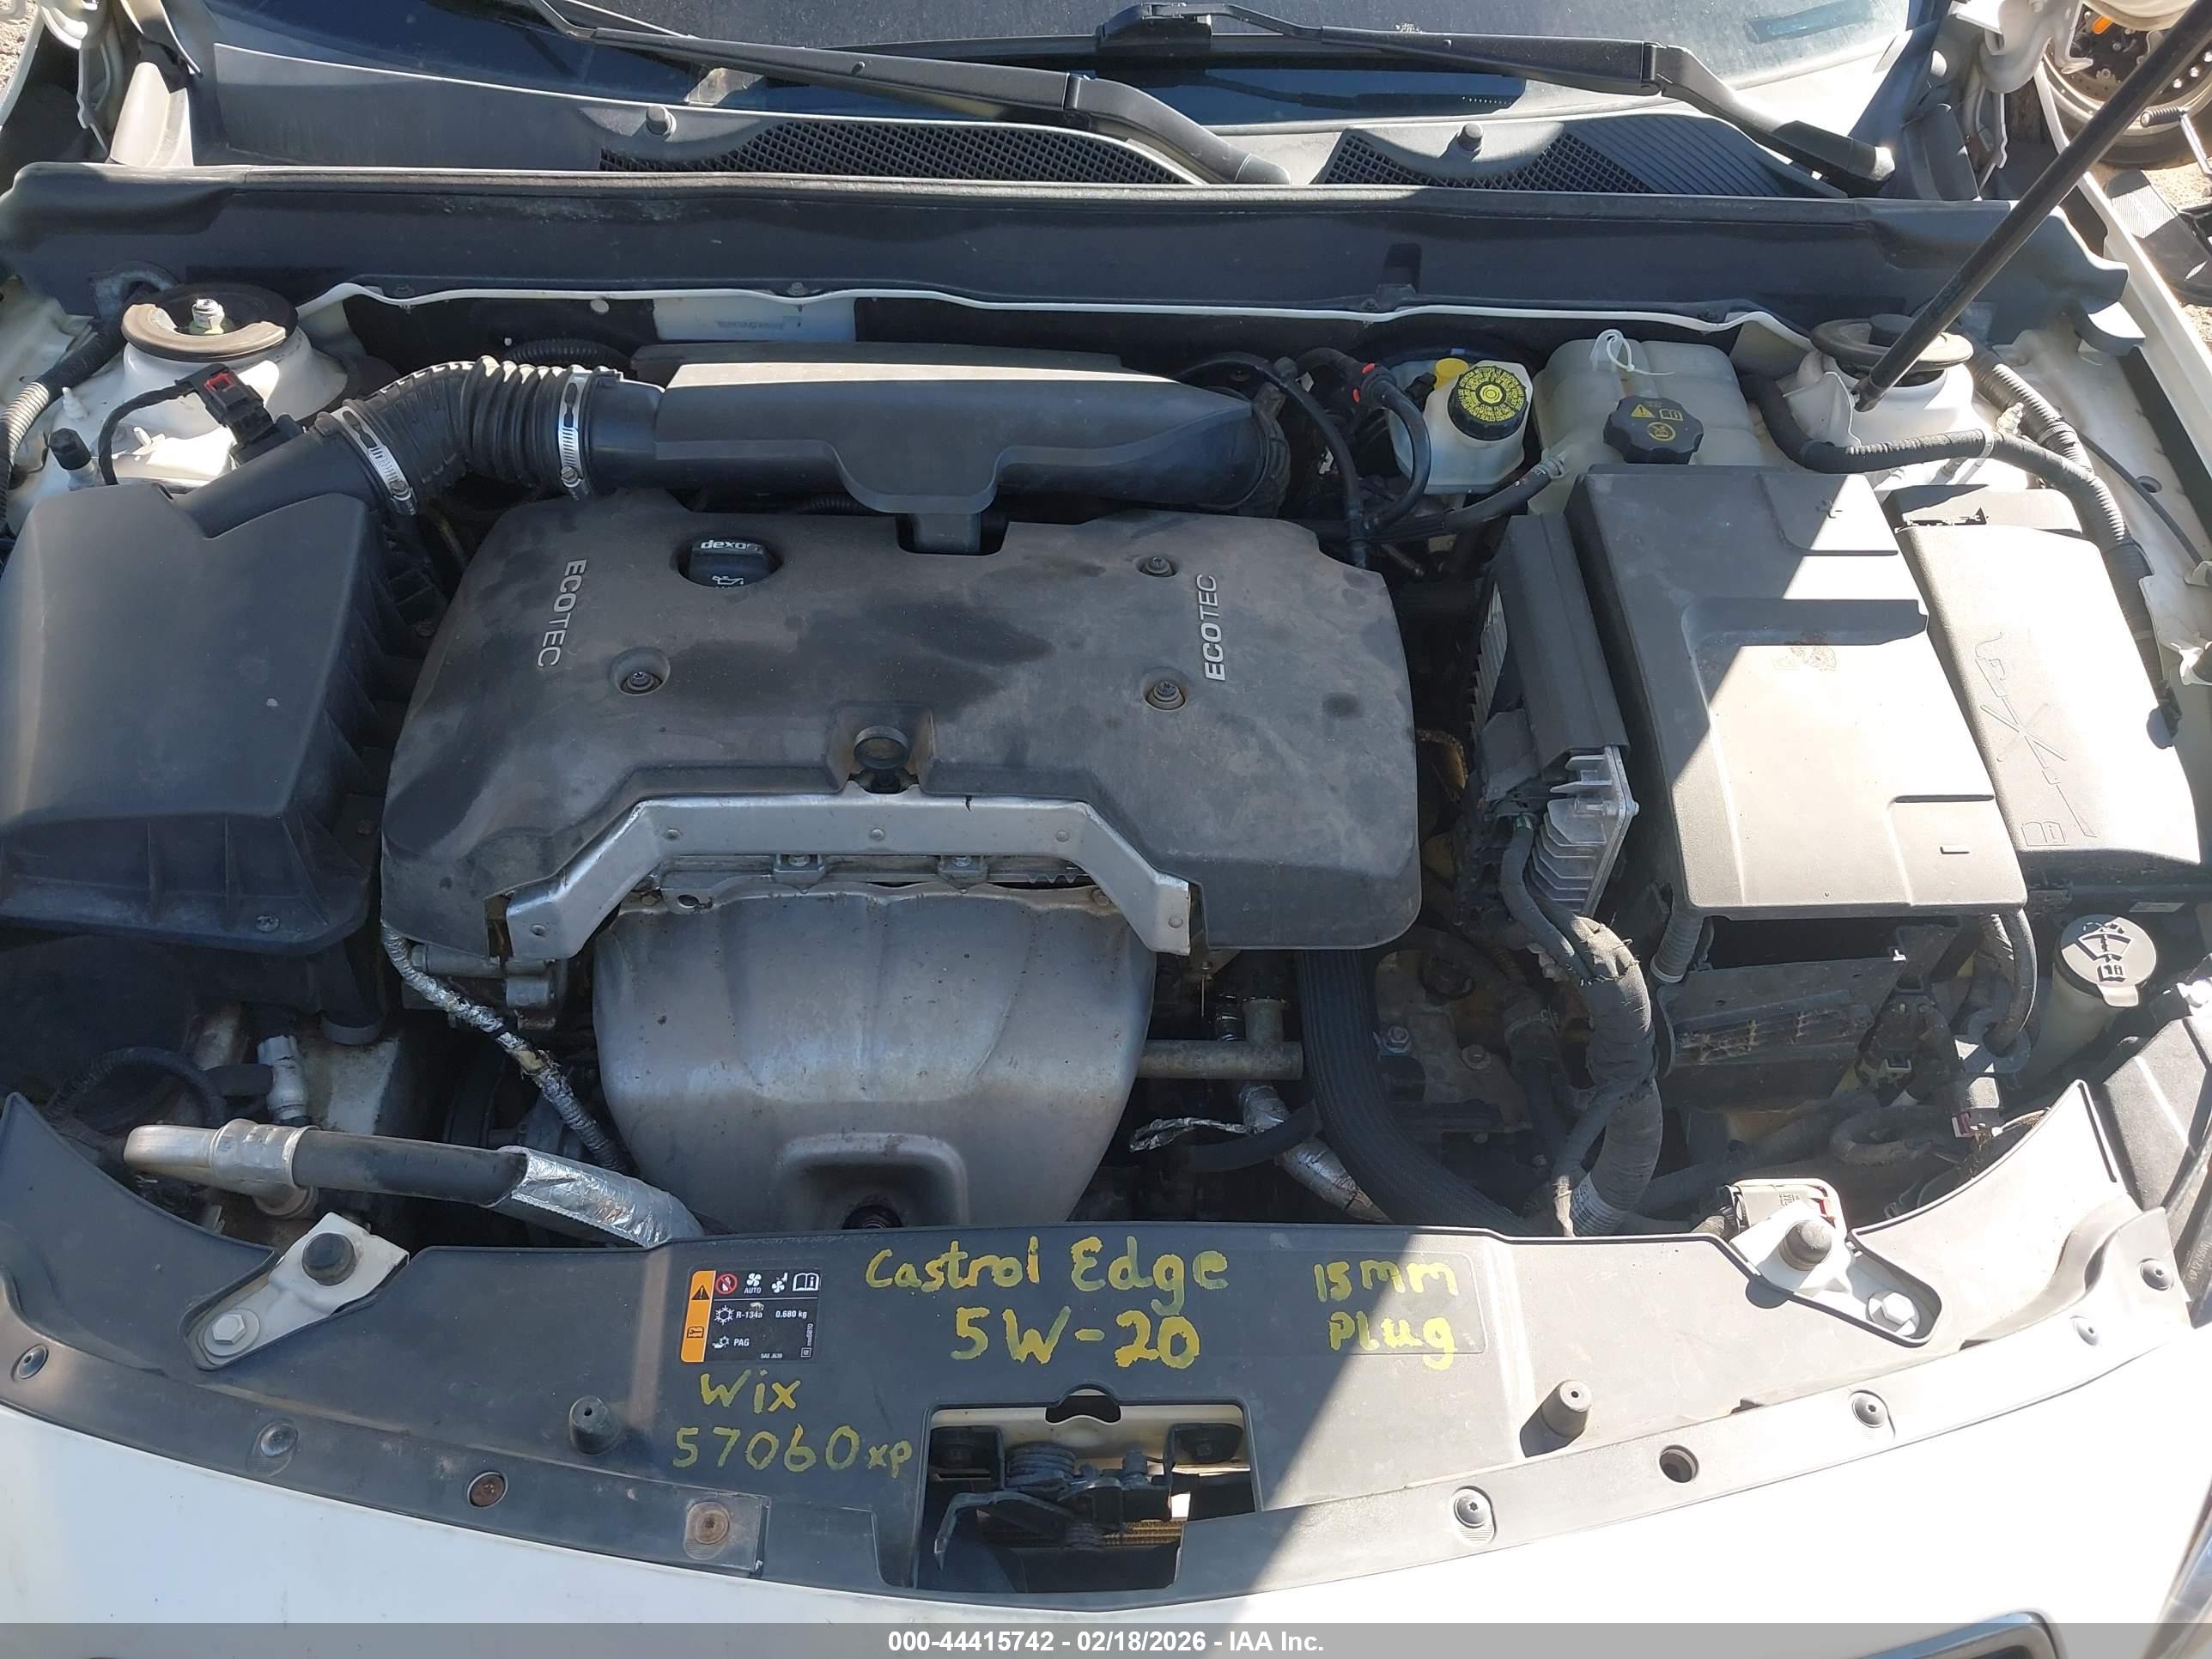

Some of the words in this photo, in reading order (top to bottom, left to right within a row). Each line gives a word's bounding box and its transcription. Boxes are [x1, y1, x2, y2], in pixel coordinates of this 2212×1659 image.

[538, 559, 587, 667] ECOTEC
[1196, 574, 1225, 681] ECOTEC
[866, 1236, 1039, 1291] Castrol
[1071, 1236, 1228, 1316] Edge
[733, 1338, 750, 1346] PAG
[736, 1310, 763, 1319] R-134a
[775, 1310, 797, 1318] 0.680
[798, 1310, 807, 1319] kg
[951, 1305, 1200, 1369] 5W-20
